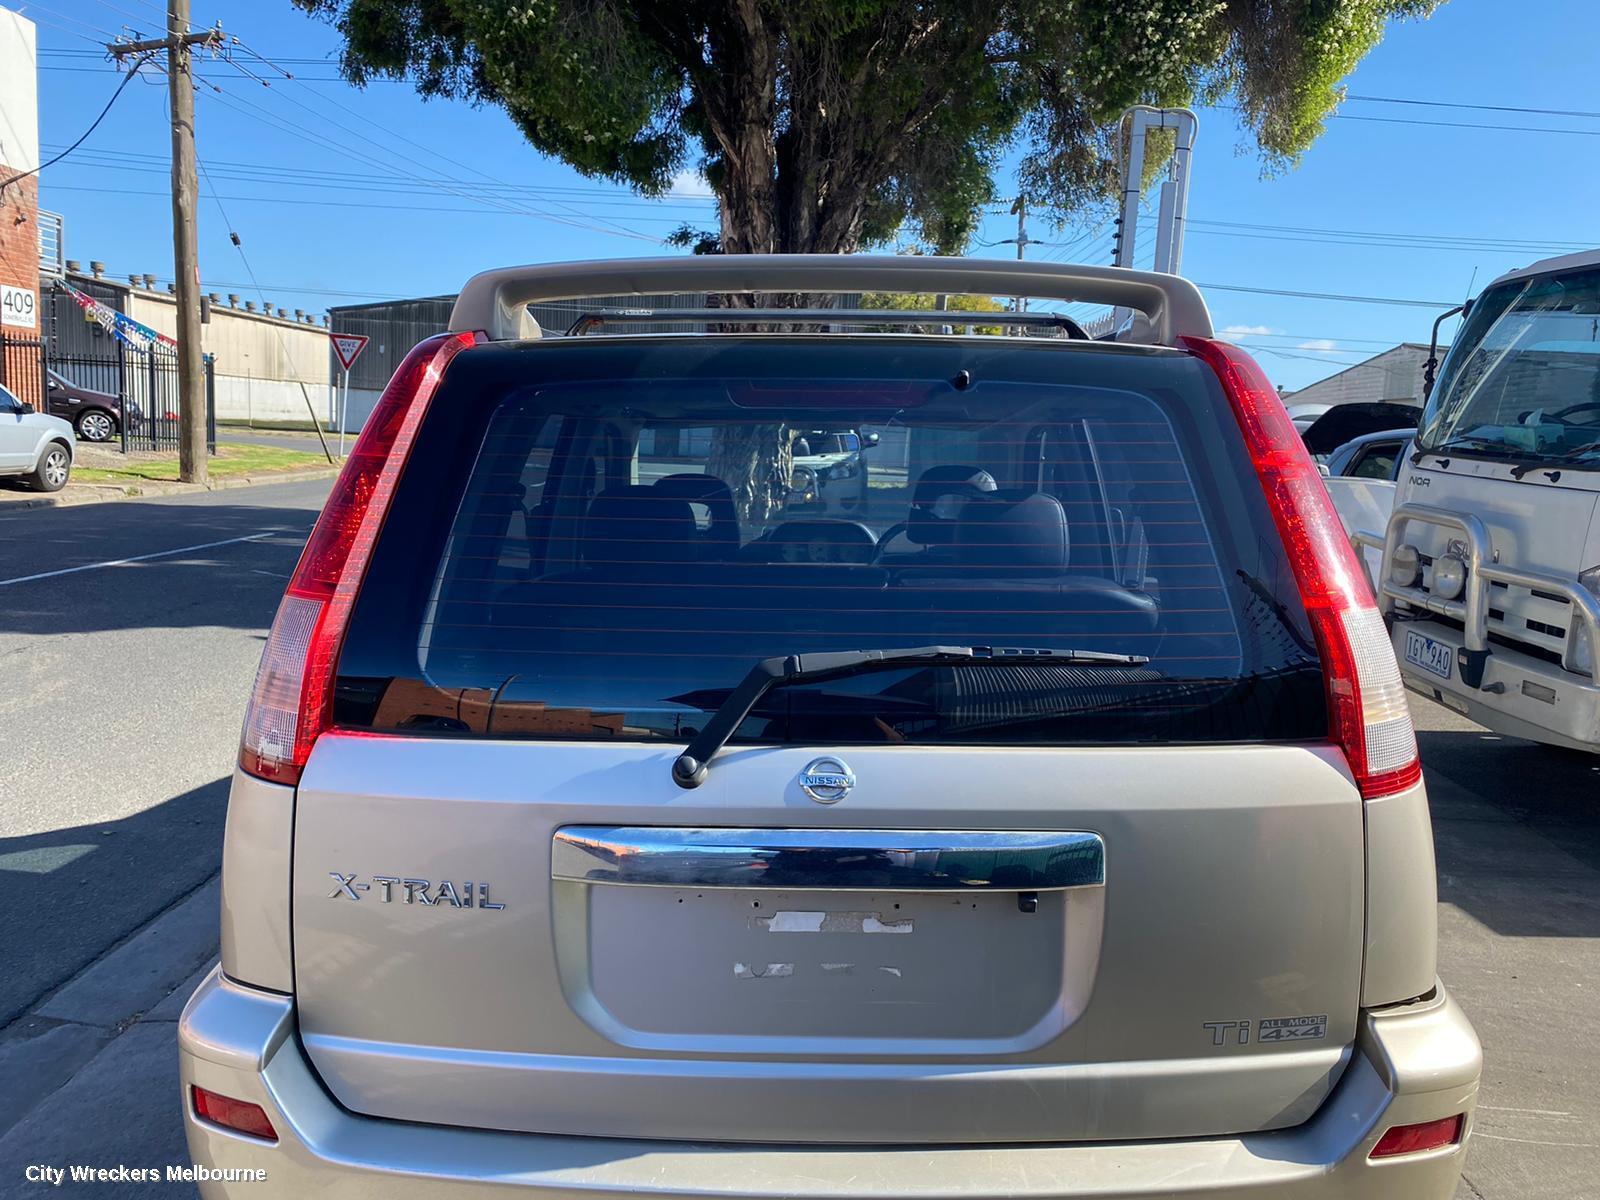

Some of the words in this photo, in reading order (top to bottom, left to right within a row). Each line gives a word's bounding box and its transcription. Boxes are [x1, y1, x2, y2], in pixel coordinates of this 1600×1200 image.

[3, 290, 33, 315] 409
[339, 340, 358, 348] GIVE
[805, 776, 850, 785] NISSAN
[327, 871, 506, 911] X-TRAIL
[1261, 1020, 1285, 1029] ALL
[1288, 1015, 1327, 1027] MODE
[1203, 1020, 1251, 1046] Ti
[1261, 1025, 1324, 1040] 4x4
